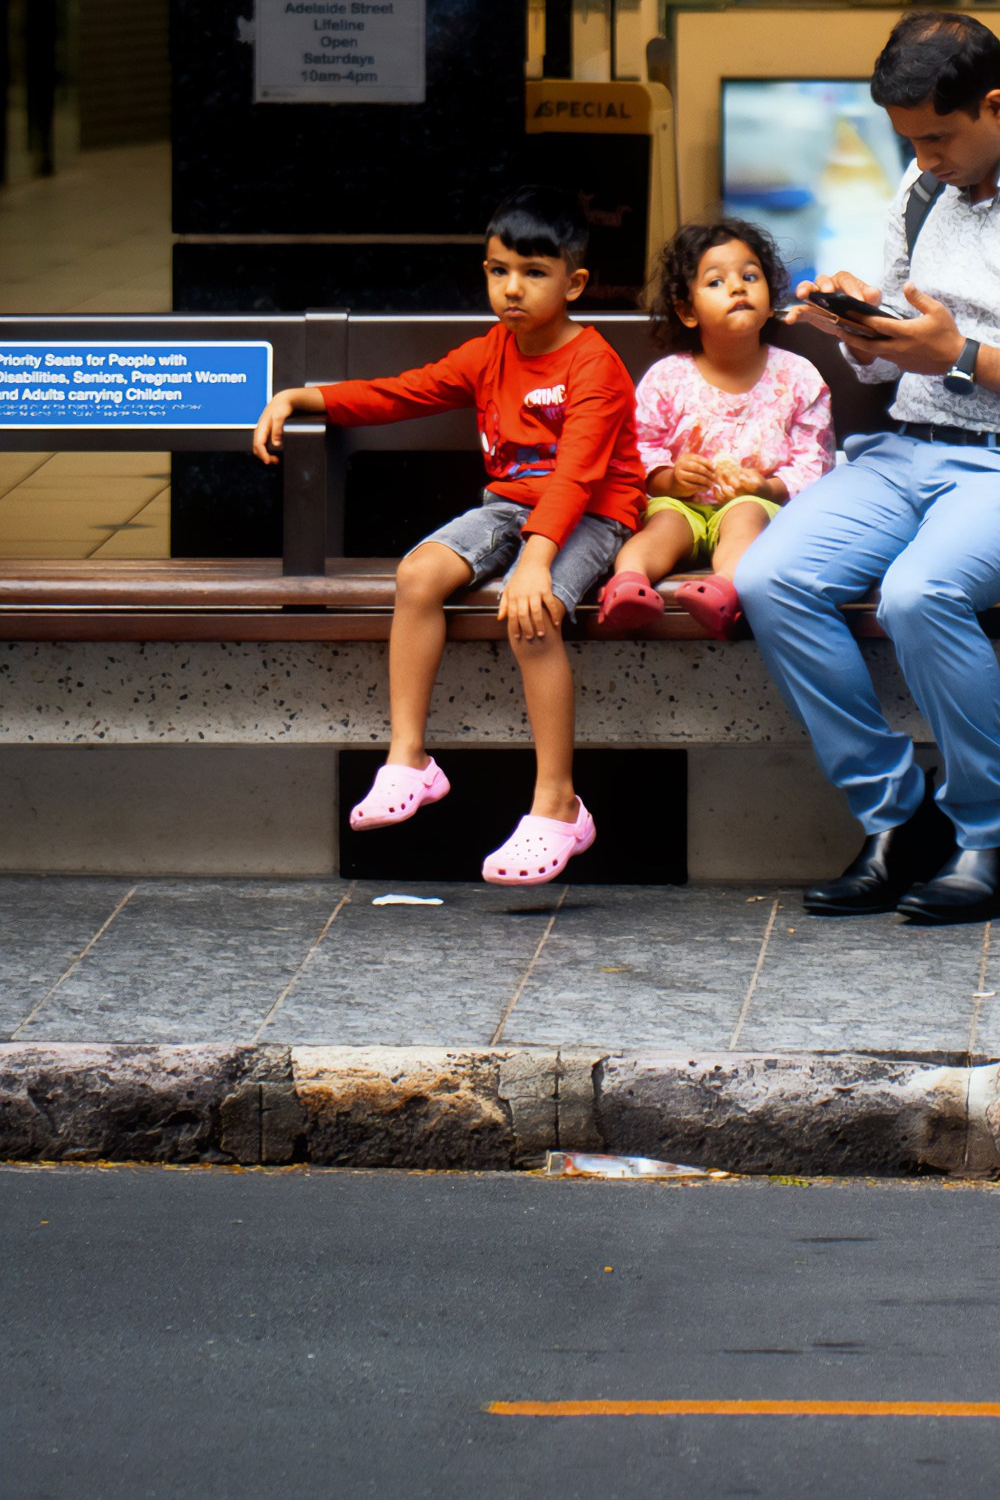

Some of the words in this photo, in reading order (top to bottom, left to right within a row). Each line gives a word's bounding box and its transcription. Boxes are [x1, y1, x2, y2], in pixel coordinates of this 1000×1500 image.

[285, 2, 347, 15] Adelaide
[351, 2, 394, 15] Street
[313, 18, 365, 32] Lifeline
[320, 35, 358, 50] Open
[44, 353, 84, 367] Seats
[86, 353, 107, 367] for
[108, 353, 156, 369] People
[158, 354, 188, 367] with
[73, 370, 129, 385] Seniors,
[131, 371, 193, 386] Pregnant
[195, 371, 247, 384] Women
[21, 388, 66, 401] Adults
[68, 388, 123, 404] carrying
[126, 388, 183, 401] Children
